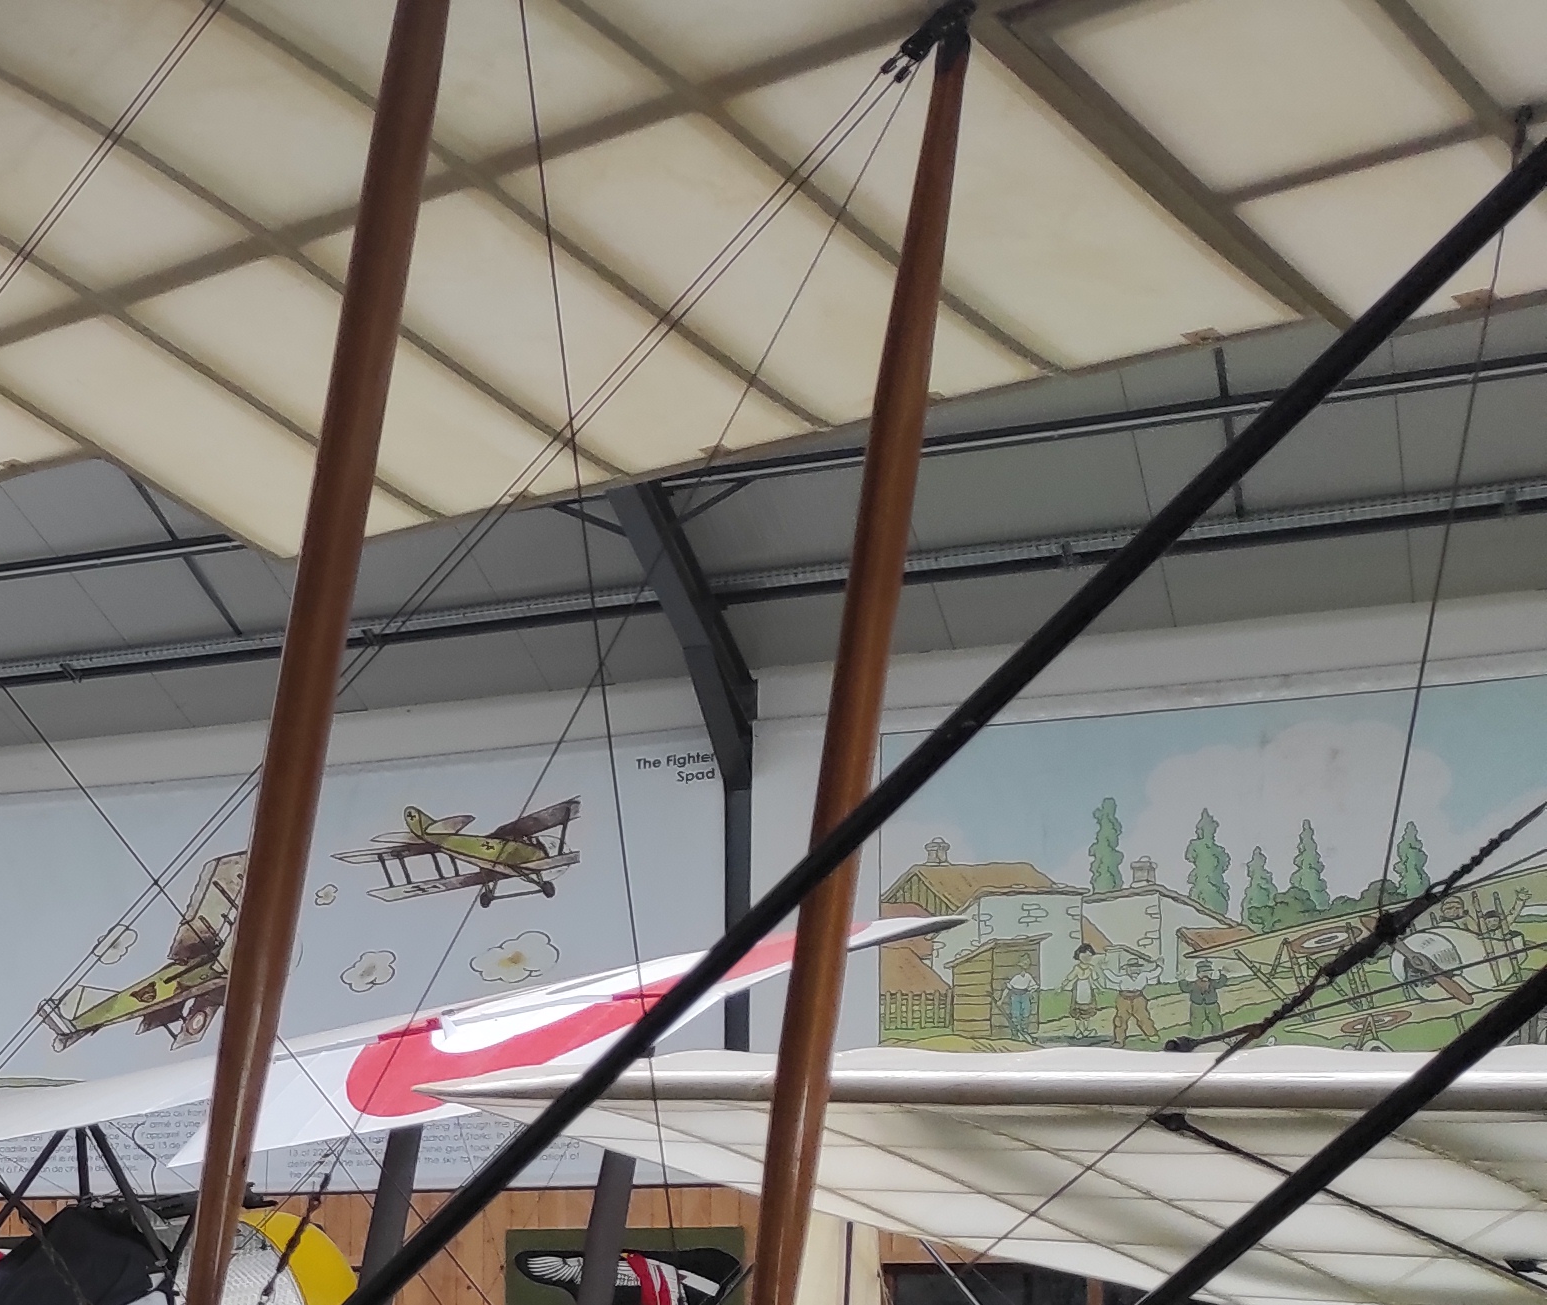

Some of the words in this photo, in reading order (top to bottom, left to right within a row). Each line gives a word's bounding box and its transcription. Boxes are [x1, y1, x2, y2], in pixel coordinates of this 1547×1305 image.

[636, 757, 662, 770] The
[666, 751, 715, 768] Fighter
[676, 767, 716, 784] Spad
